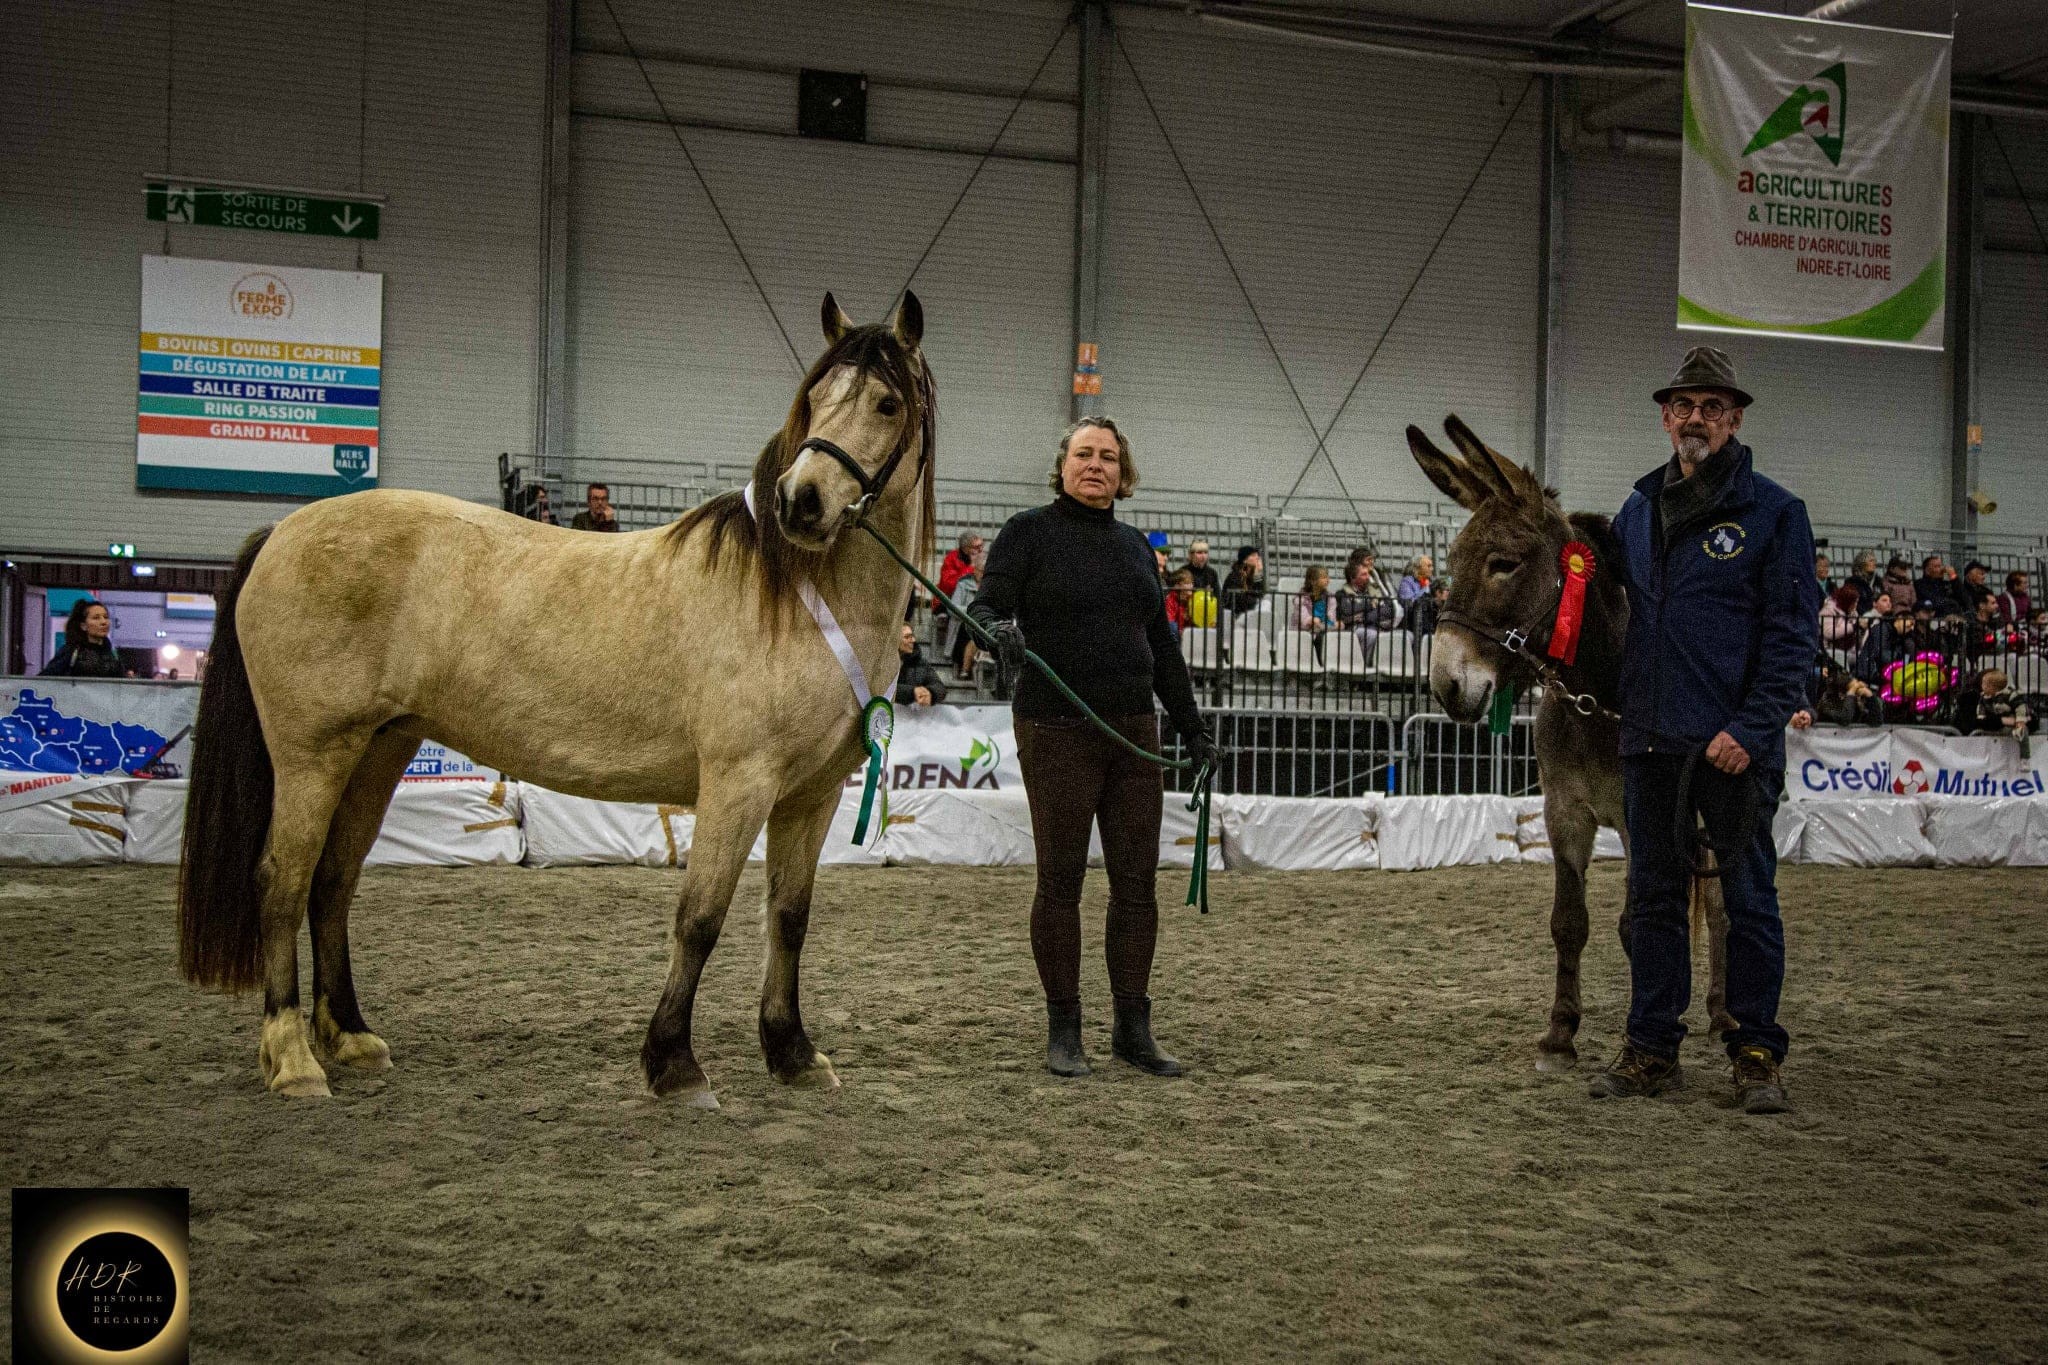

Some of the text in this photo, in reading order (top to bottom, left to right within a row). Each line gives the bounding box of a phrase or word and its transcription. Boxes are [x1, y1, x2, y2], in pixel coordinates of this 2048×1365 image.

[222, 193, 308, 213] SORTIE DE
[221, 210, 307, 231] SECOURS
[1748, 202, 1893, 236] & TERRITOIRES
[1735, 230, 1892, 259] CHAMBRE D'AGRICULTURE
[1796, 259, 1891, 281] INDRE-ET-LOIRE
[238, 291, 286, 306] FERME
[242, 304, 283, 317] EXPO
[158, 338, 362, 362] BOVINS OVINS CAPRINS
[172, 355, 347, 382] DÉGUSTATION DE LAIT
[192, 380, 326, 402] SALLE DE TRAITE
[204, 402, 317, 421] RING PASSION
[210, 423, 311, 441] GRAND HALL
[340, 450, 364, 460] VERS
[405, 761, 473, 773] PERT de la
[1934, 768, 2045, 797] Mutuel
